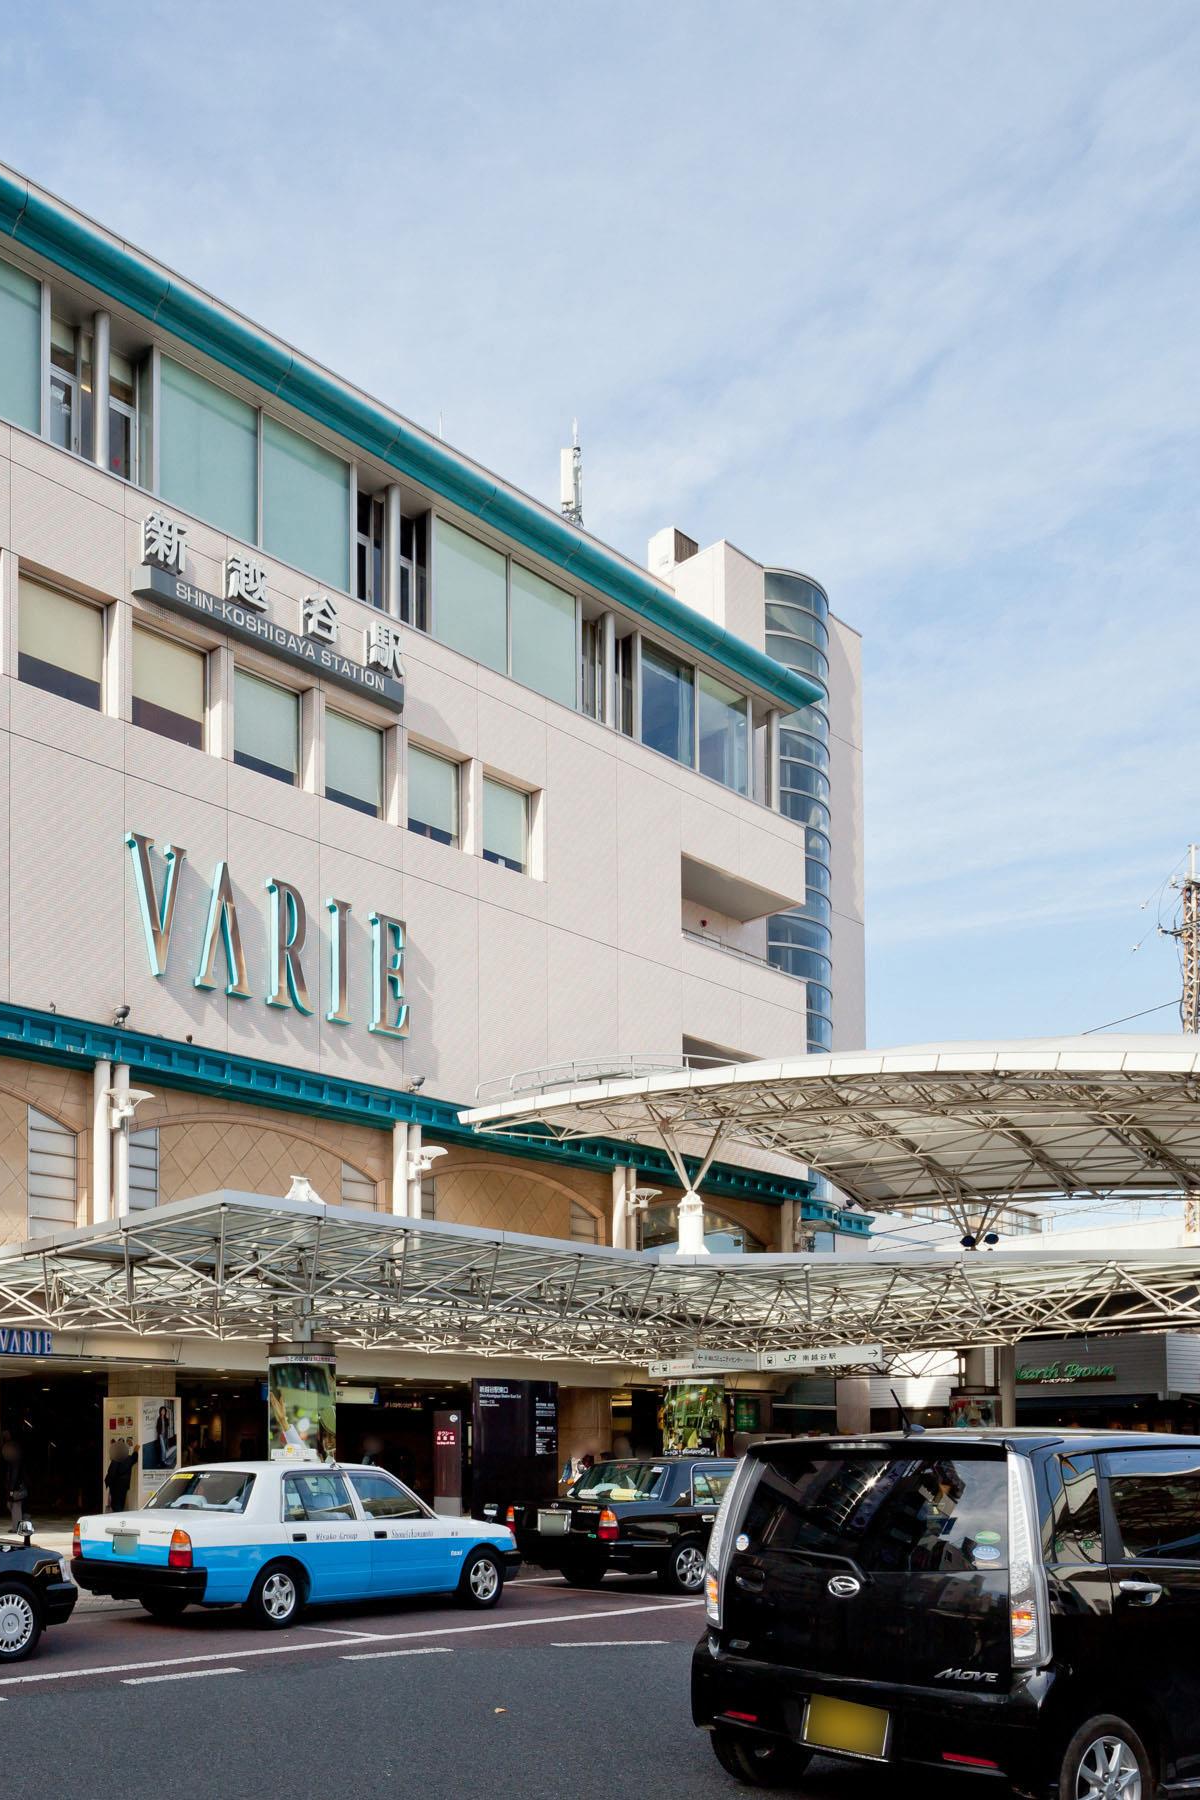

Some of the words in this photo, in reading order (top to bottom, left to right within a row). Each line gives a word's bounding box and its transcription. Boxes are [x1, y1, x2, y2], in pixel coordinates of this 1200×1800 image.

[141, 510, 406, 678] 新越谷駅
[175, 581, 316, 658] SHIN-KOSHIGAYA
[321, 650, 386, 693] STATION
[125, 831, 411, 1040] VARIE
[783, 1354, 797, 1362] JR
[802, 1352, 837, 1362] 南越谷駅
[1064, 1362, 1115, 1378] Brown
[934, 1667, 999, 1682] MOVE
